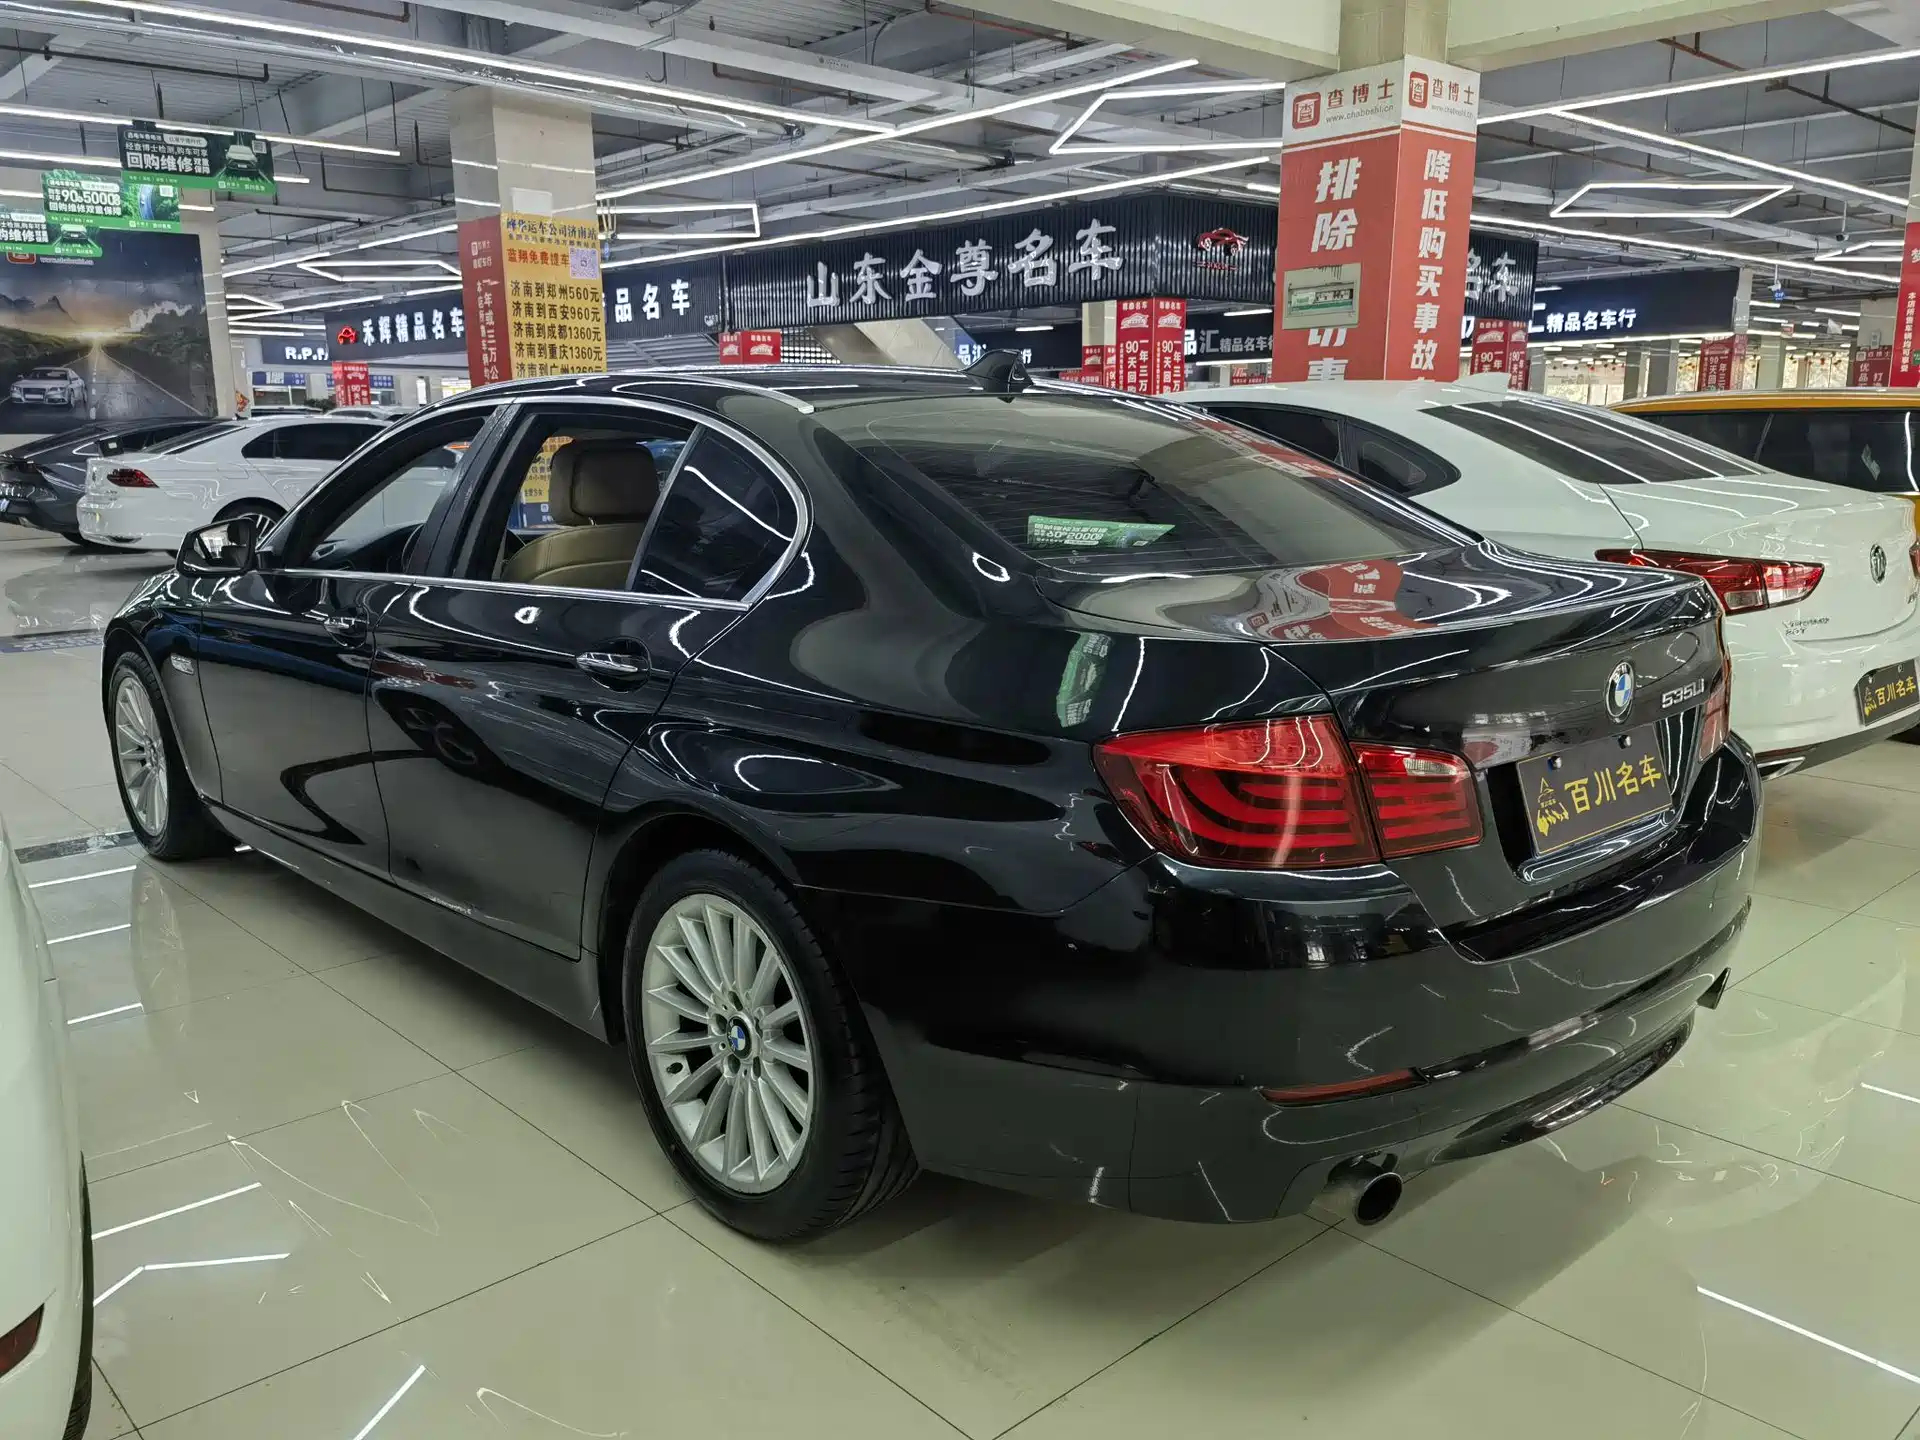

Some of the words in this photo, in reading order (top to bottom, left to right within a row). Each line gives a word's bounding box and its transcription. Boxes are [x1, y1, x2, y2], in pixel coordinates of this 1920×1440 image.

[1327, 78, 1395, 110] 查博士
[1432, 77, 1475, 106] 查博士
[1326, 104, 1394, 124] www.chaboshi.cn
[127, 151, 193, 173] 回购维修
[807, 218, 1123, 307] 山东金尊名车
[1411, 149, 1451, 382] 降低购买事故
[510, 280, 600, 303] 济南到郑州560元
[602, 279, 690, 323] 品名车
[362, 307, 464, 347] 禾辉精品名车
[512, 301, 601, 323] 济南到西安960元
[1547, 308, 1637, 333] 精品名车行
[476, 280, 491, 385] 本店所售车辆均
[513, 322, 602, 342] 济南到成都1360元
[1901, 292, 1917, 373] 本店所售车辆均可享受
[515, 341, 603, 362] 济南到重庆1360元
[1875, 676, 1917, 706] 百川名车
[1564, 755, 1662, 814] 百川名车
